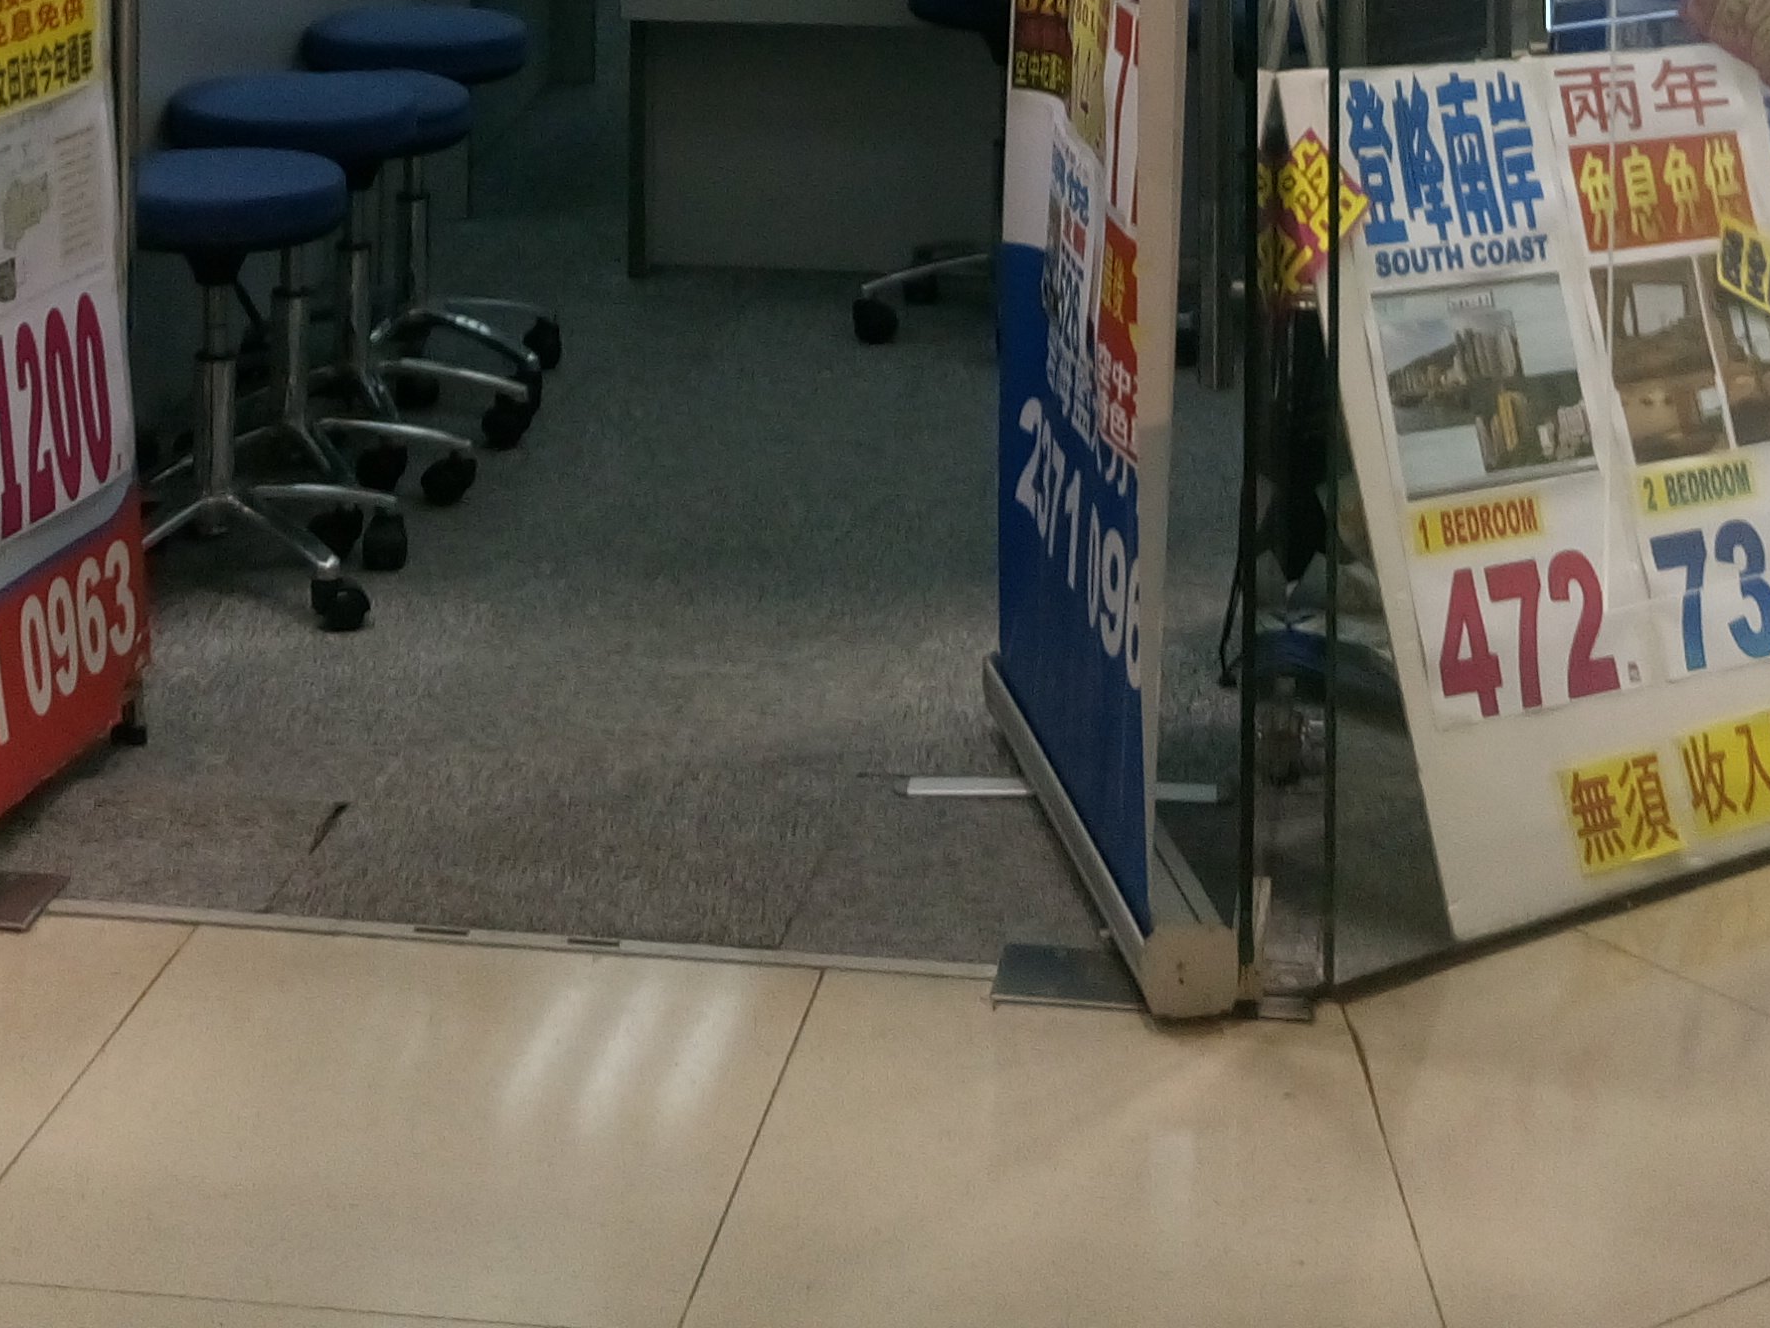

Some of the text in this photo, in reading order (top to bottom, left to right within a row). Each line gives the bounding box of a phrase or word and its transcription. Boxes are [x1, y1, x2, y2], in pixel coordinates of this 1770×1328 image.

[1552, 58, 1730, 137] 兩年
[1346, 71, 1544, 246] 登峰南岸
[1578, 138, 1740, 244] 免息免供
[1374, 235, 1549, 279] SOUTH COAST
[1440, 497, 1539, 546] BEDROOM
[1642, 460, 1752, 512] 2 BEDROOM
[21, 539, 138, 717] 0963
[1438, 548, 1622, 717] 472
[1571, 750, 1681, 866] 無須
